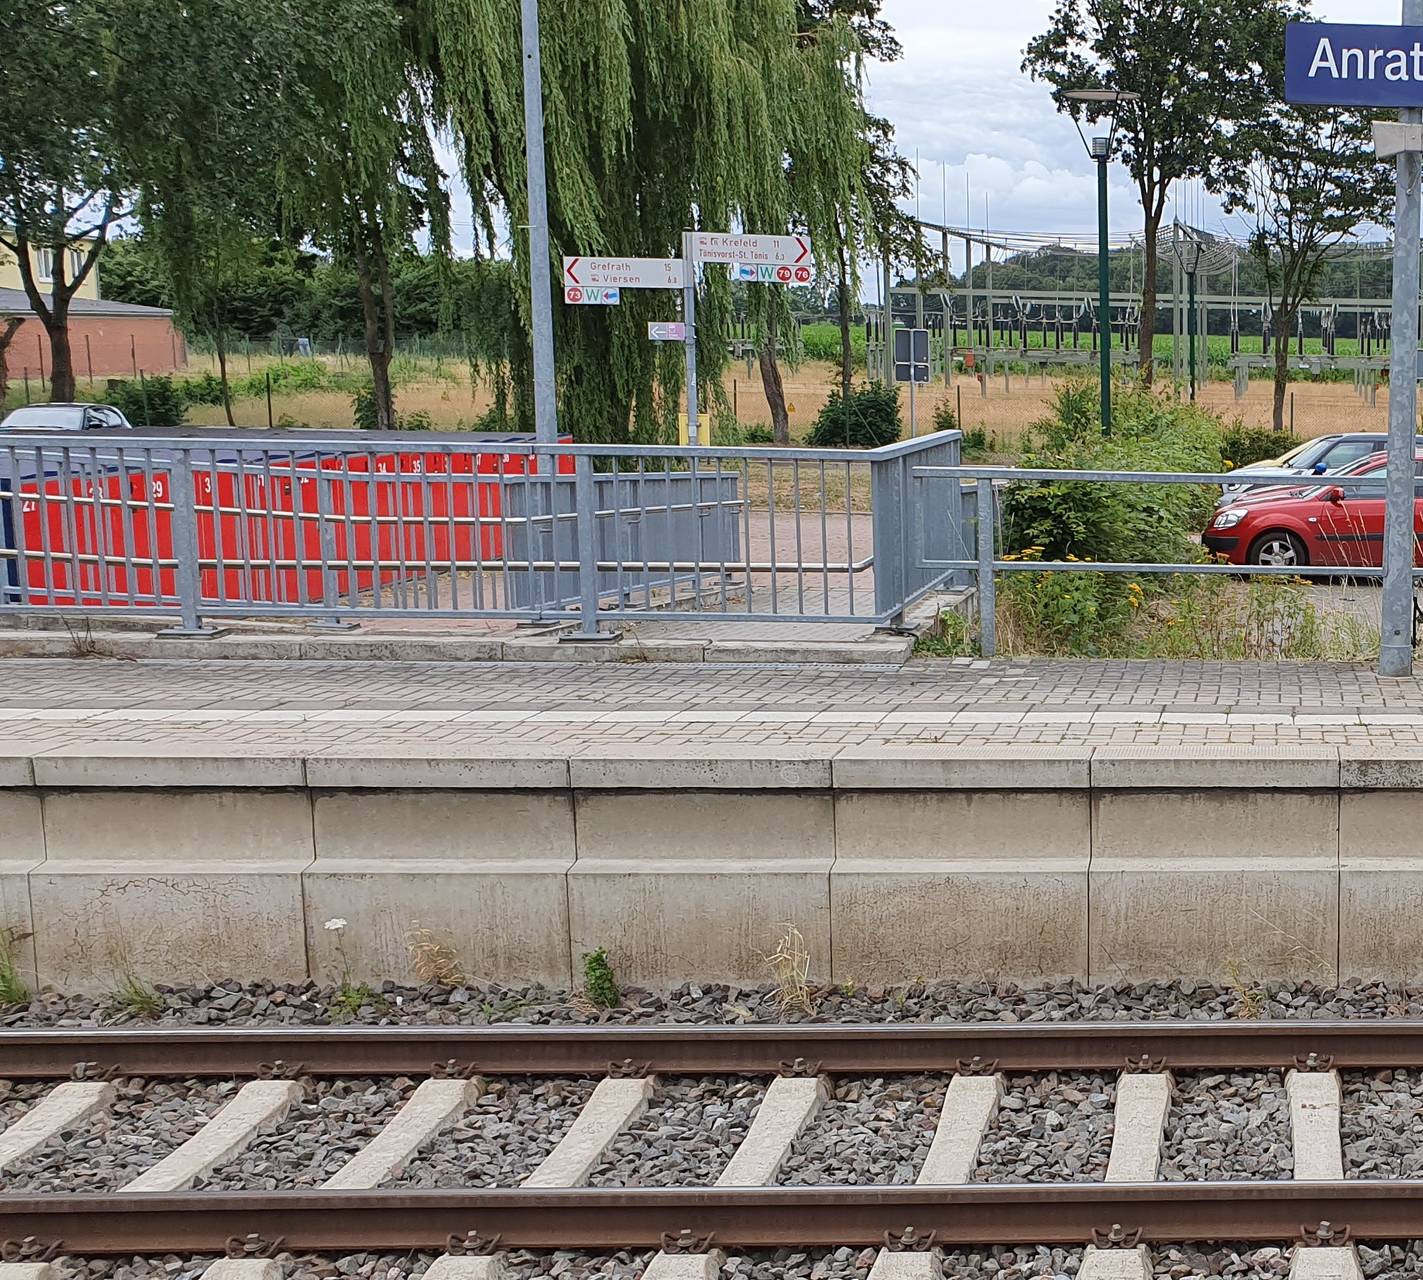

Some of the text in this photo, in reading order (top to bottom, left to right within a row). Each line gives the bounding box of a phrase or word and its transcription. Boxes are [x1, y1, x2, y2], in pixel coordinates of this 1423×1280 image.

[722, 238, 780, 249] Krefeld 11
[590, 261, 672, 272] Grefrath 15
[603, 274, 641, 284] Viersen
[760, 267, 809, 279] W 79 76
[568, 289, 600, 301] 73 W
[412, 460, 421, 474] 35
[152, 480, 164, 498] 29
